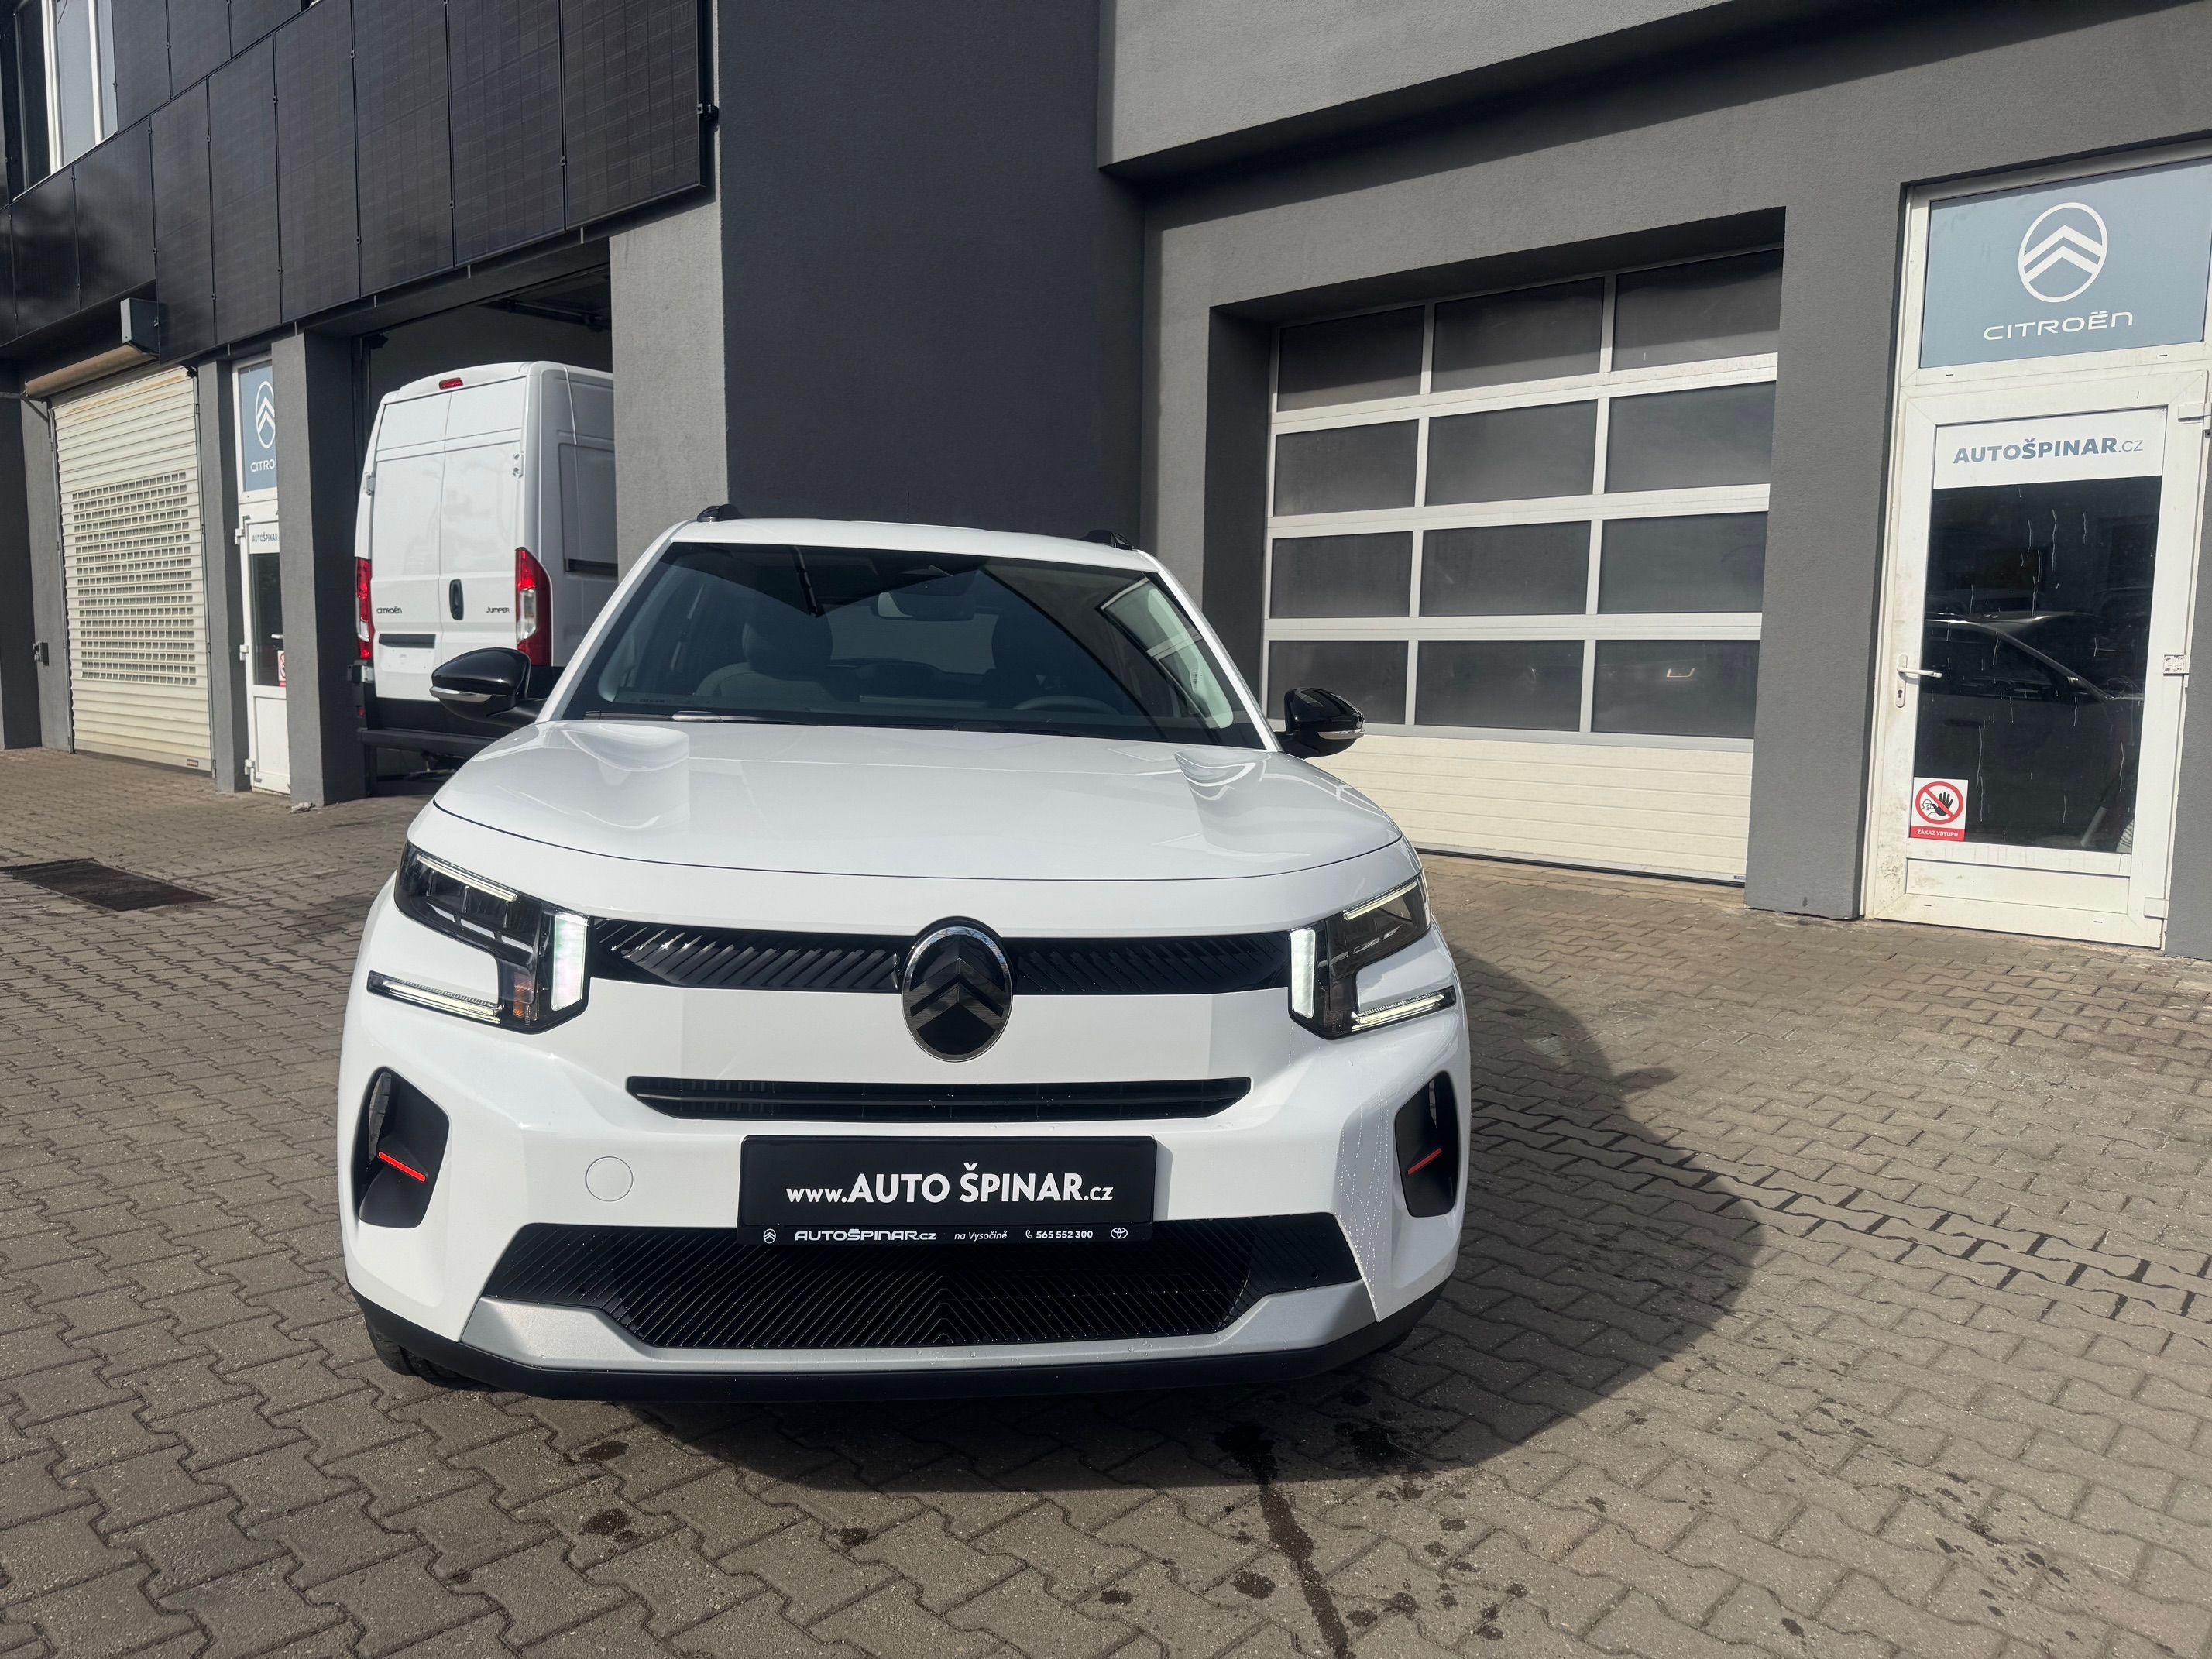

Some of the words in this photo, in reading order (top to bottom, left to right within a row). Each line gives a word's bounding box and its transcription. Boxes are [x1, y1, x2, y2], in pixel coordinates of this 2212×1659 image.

[250, 459, 277, 472] CITRO
[785, 1173, 950, 1204] www.AUTO
[959, 1163, 1115, 1203] ŠPINAR.cz
[954, 1231, 966, 1240] na
[968, 1230, 1008, 1242] Vysočině
[1036, 1230, 1054, 1239] 565
[1056, 1230, 1073, 1239] 552
[1075, 1230, 1094, 1239] 300
